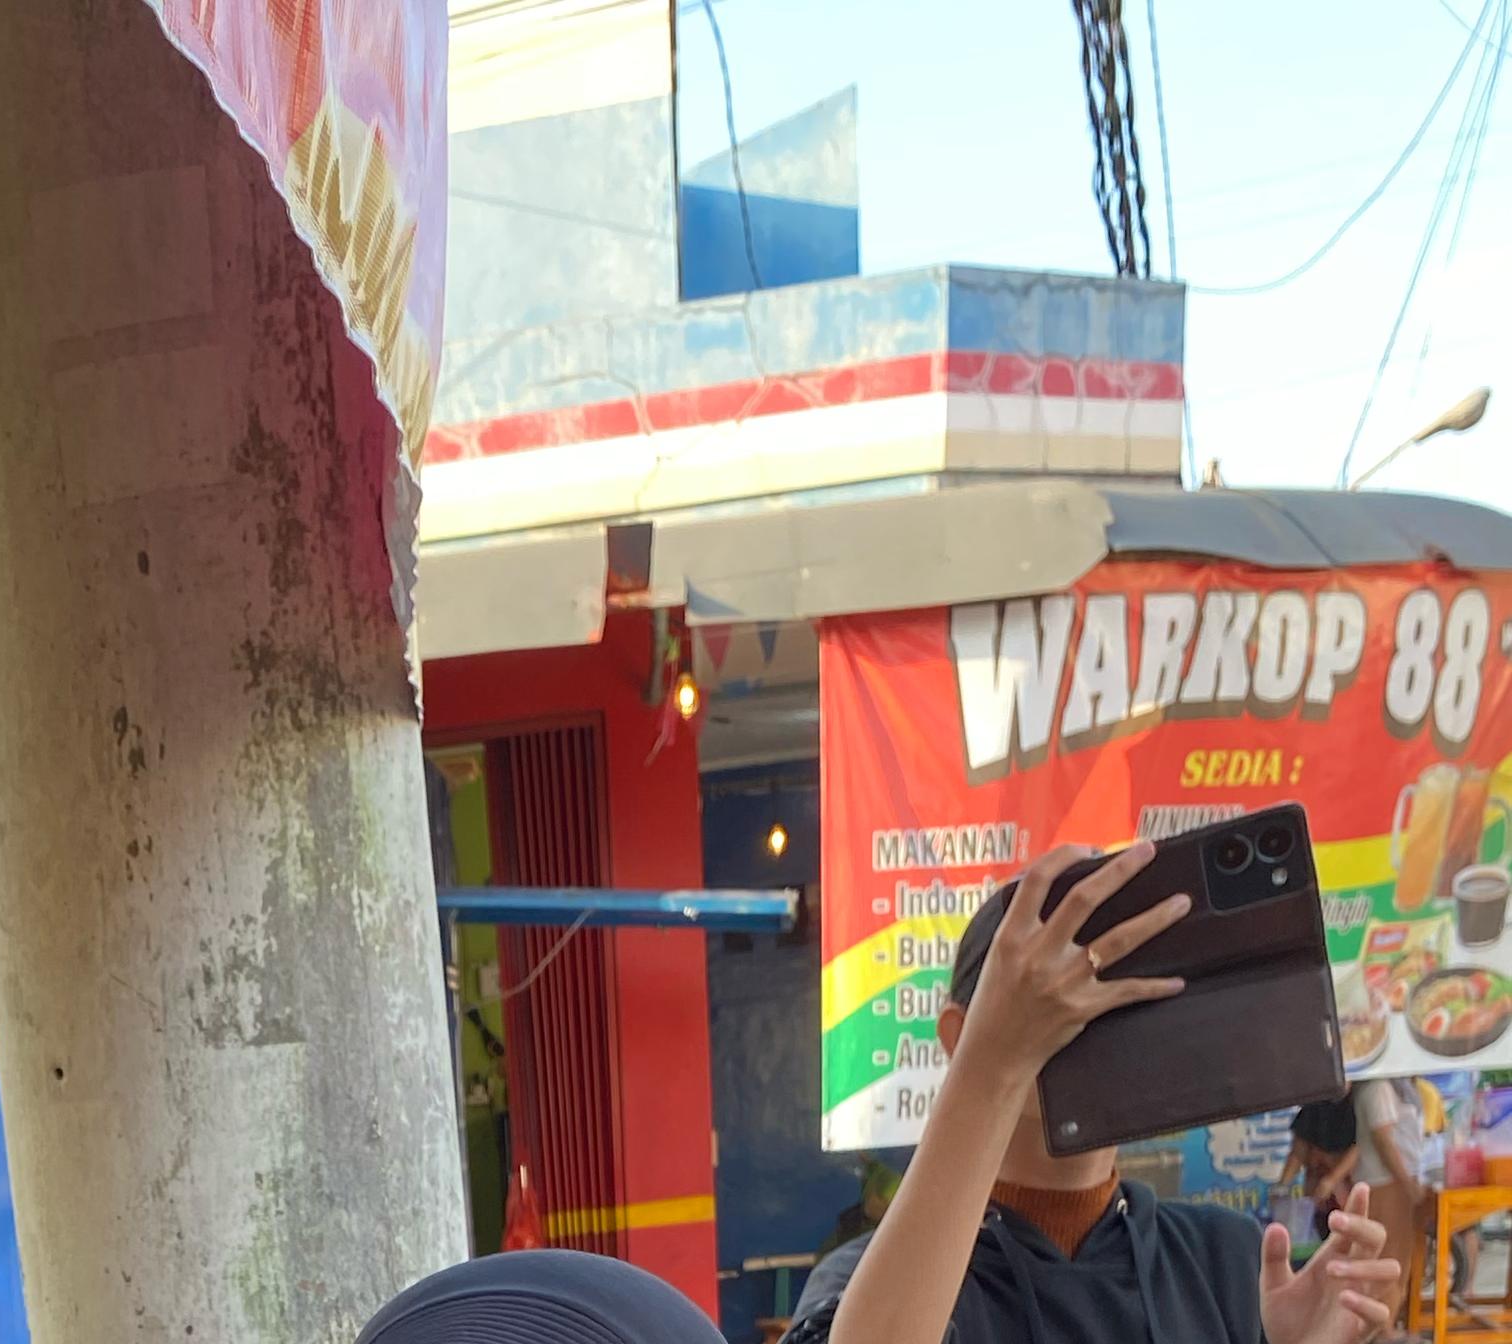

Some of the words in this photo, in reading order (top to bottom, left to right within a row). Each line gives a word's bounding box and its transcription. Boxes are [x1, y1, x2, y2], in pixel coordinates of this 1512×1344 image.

[950, 588, 1367, 771] WARKOP
[1385, 587, 1489, 745] 88
[1180, 750, 1283, 788] SEDIA
[899, 934, 960, 967] Bub
